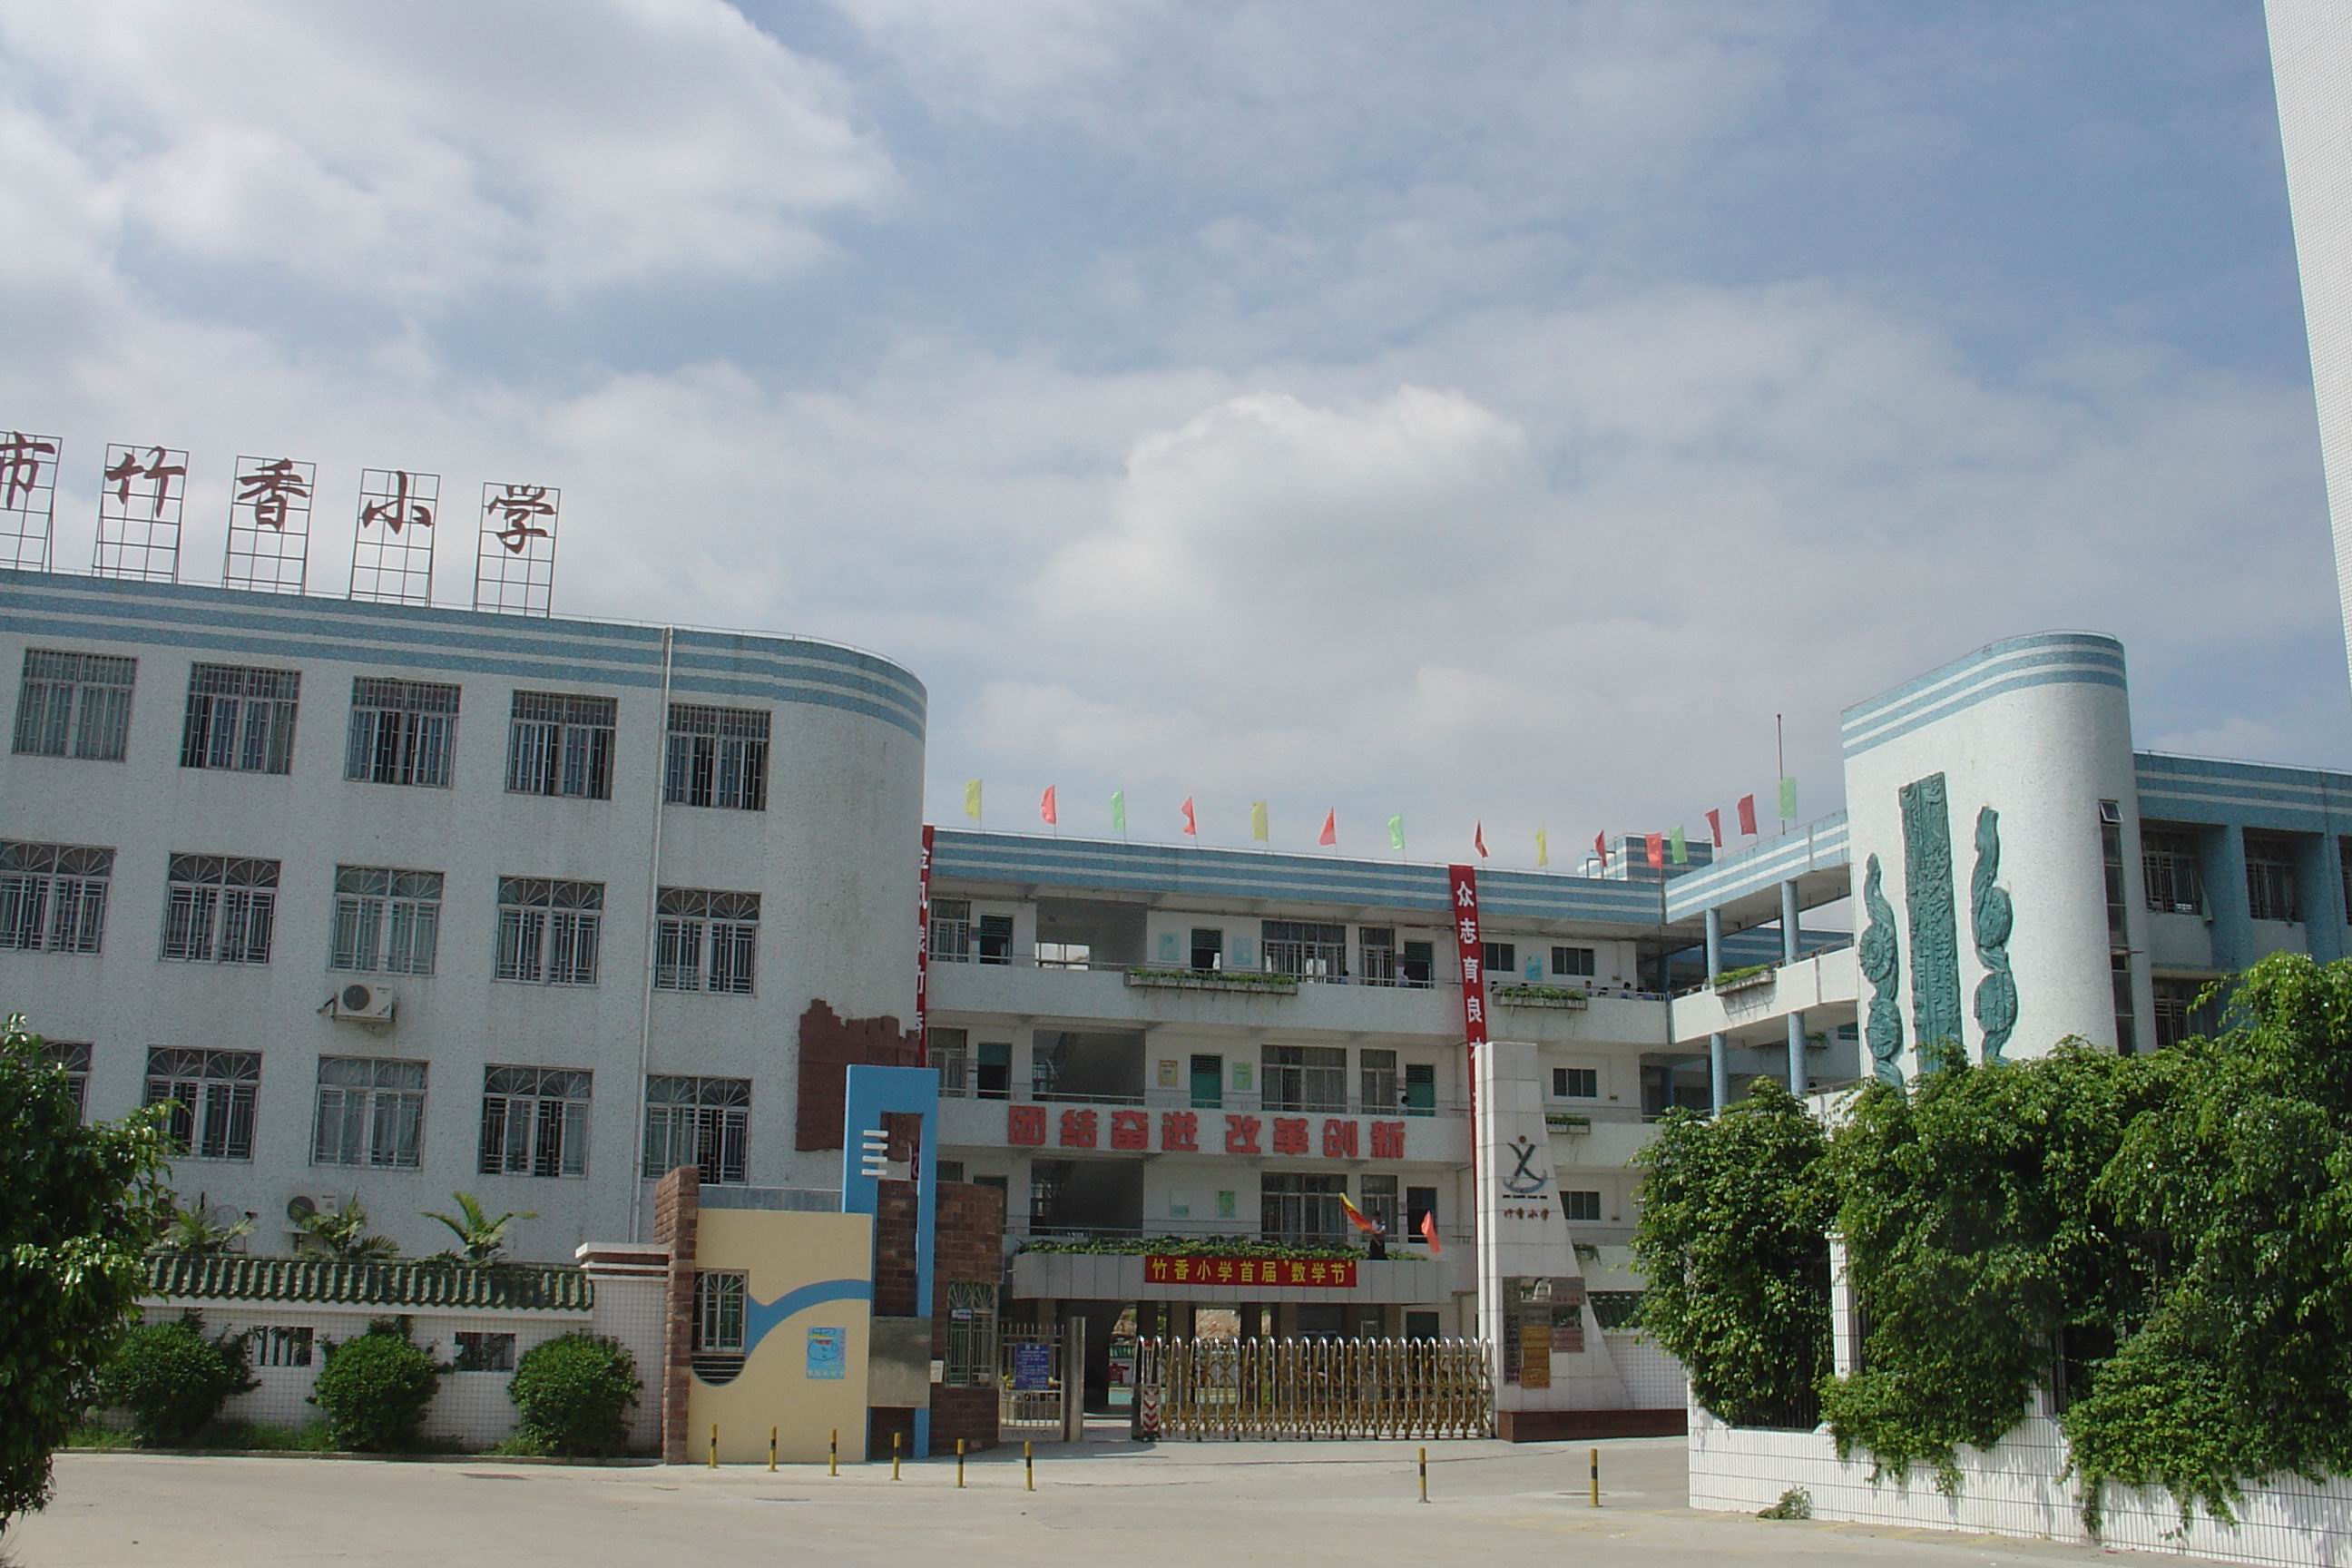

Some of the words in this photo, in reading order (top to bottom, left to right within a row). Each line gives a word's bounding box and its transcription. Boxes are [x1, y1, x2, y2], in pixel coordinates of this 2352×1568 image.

[0, 430, 555, 554] 市竹香小学
[1008, 1105, 1199, 1152] 团结奋进
[1225, 1114, 1406, 1159] 改革创新
